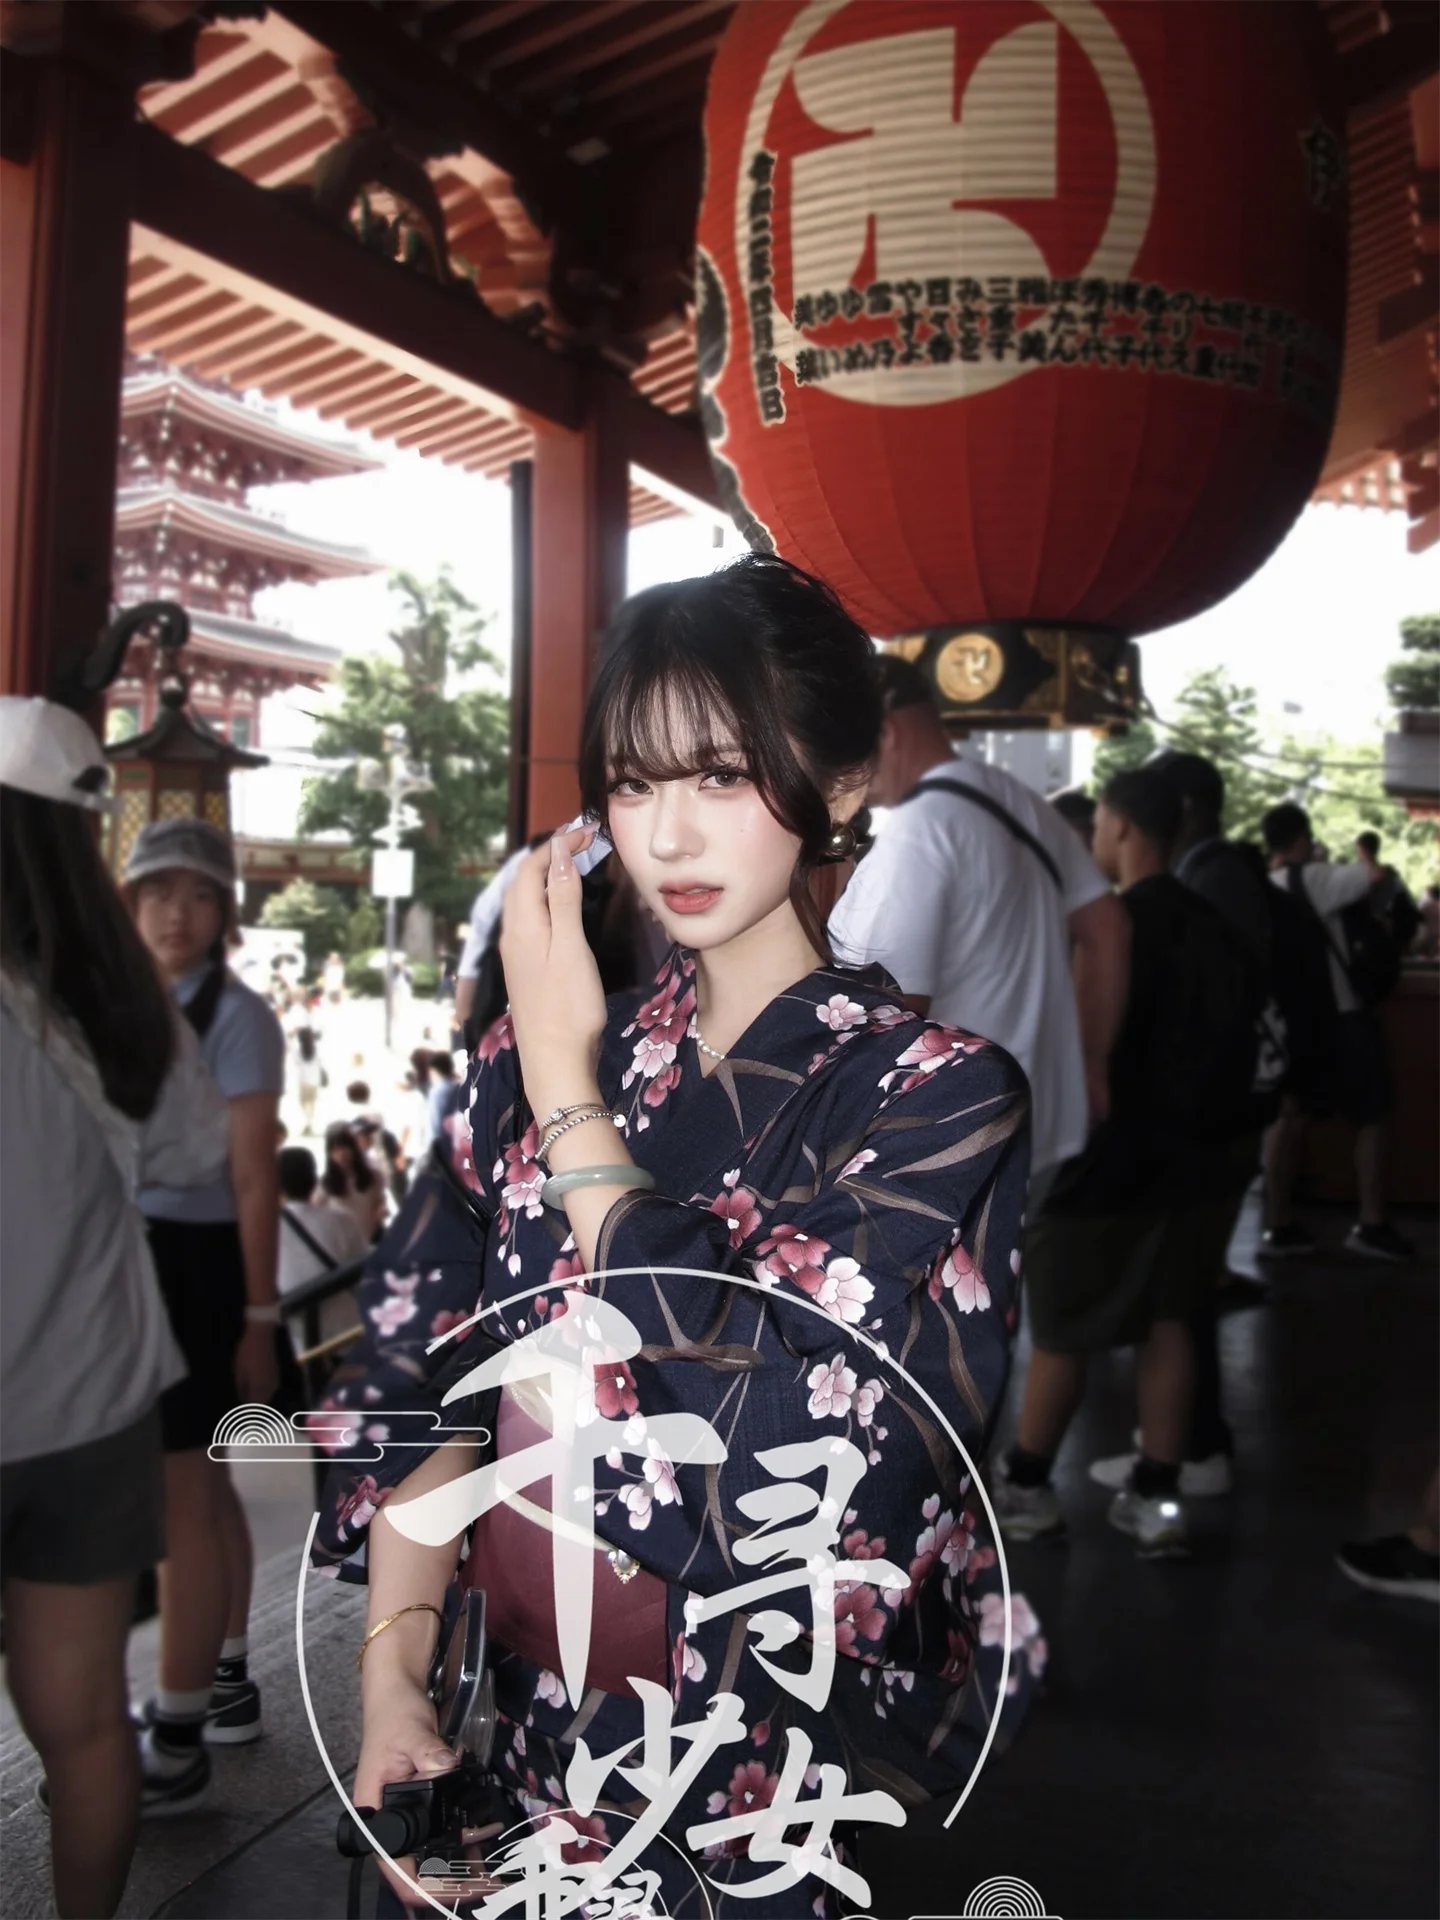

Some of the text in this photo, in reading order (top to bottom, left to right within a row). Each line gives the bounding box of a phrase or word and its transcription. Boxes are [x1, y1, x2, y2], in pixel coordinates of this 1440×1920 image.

[986, 277, 1016, 361] 三重子
[1050, 278, 1079, 363] ぼたん
